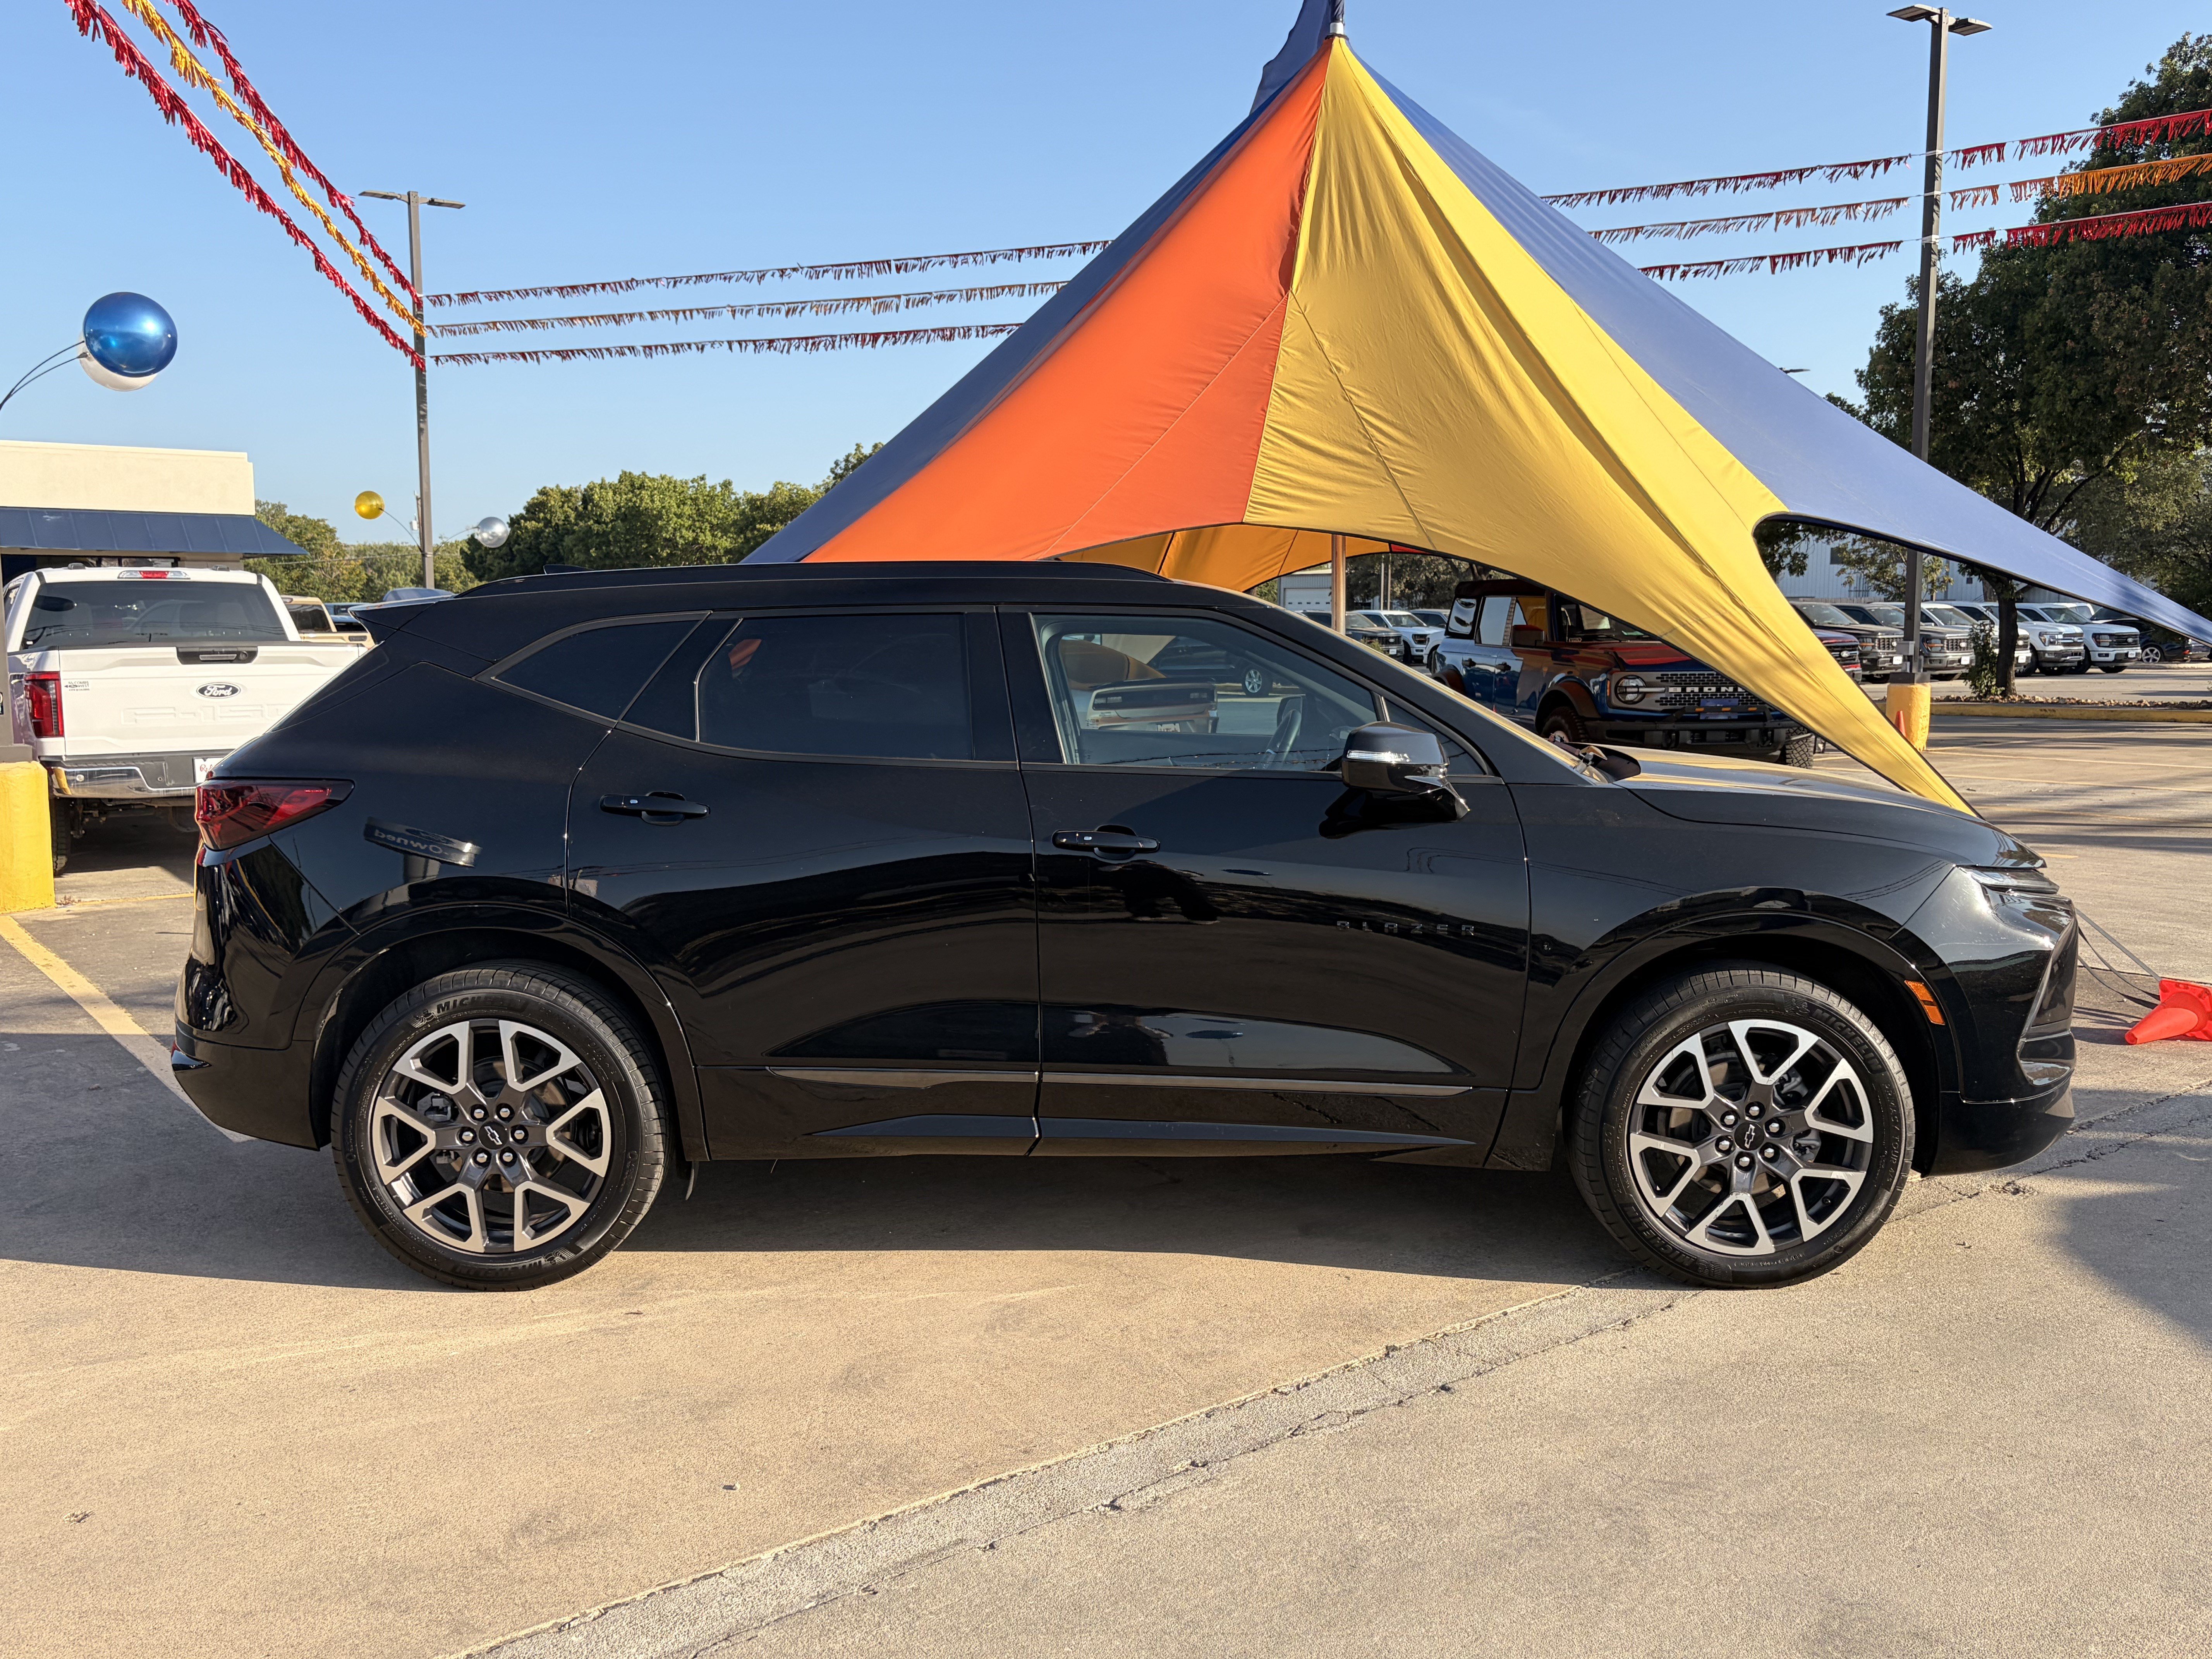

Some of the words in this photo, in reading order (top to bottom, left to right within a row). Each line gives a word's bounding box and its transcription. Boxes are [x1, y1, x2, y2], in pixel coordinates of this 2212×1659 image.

[204, 685, 232, 696] Ford
[1337, 921, 1474, 936] BLAZER
[1812, 1008, 1882, 1071] MICHELIN
[1890, 1135, 1899, 1164] TOUR
[1623, 1206, 1696, 1266] MICHELIN
